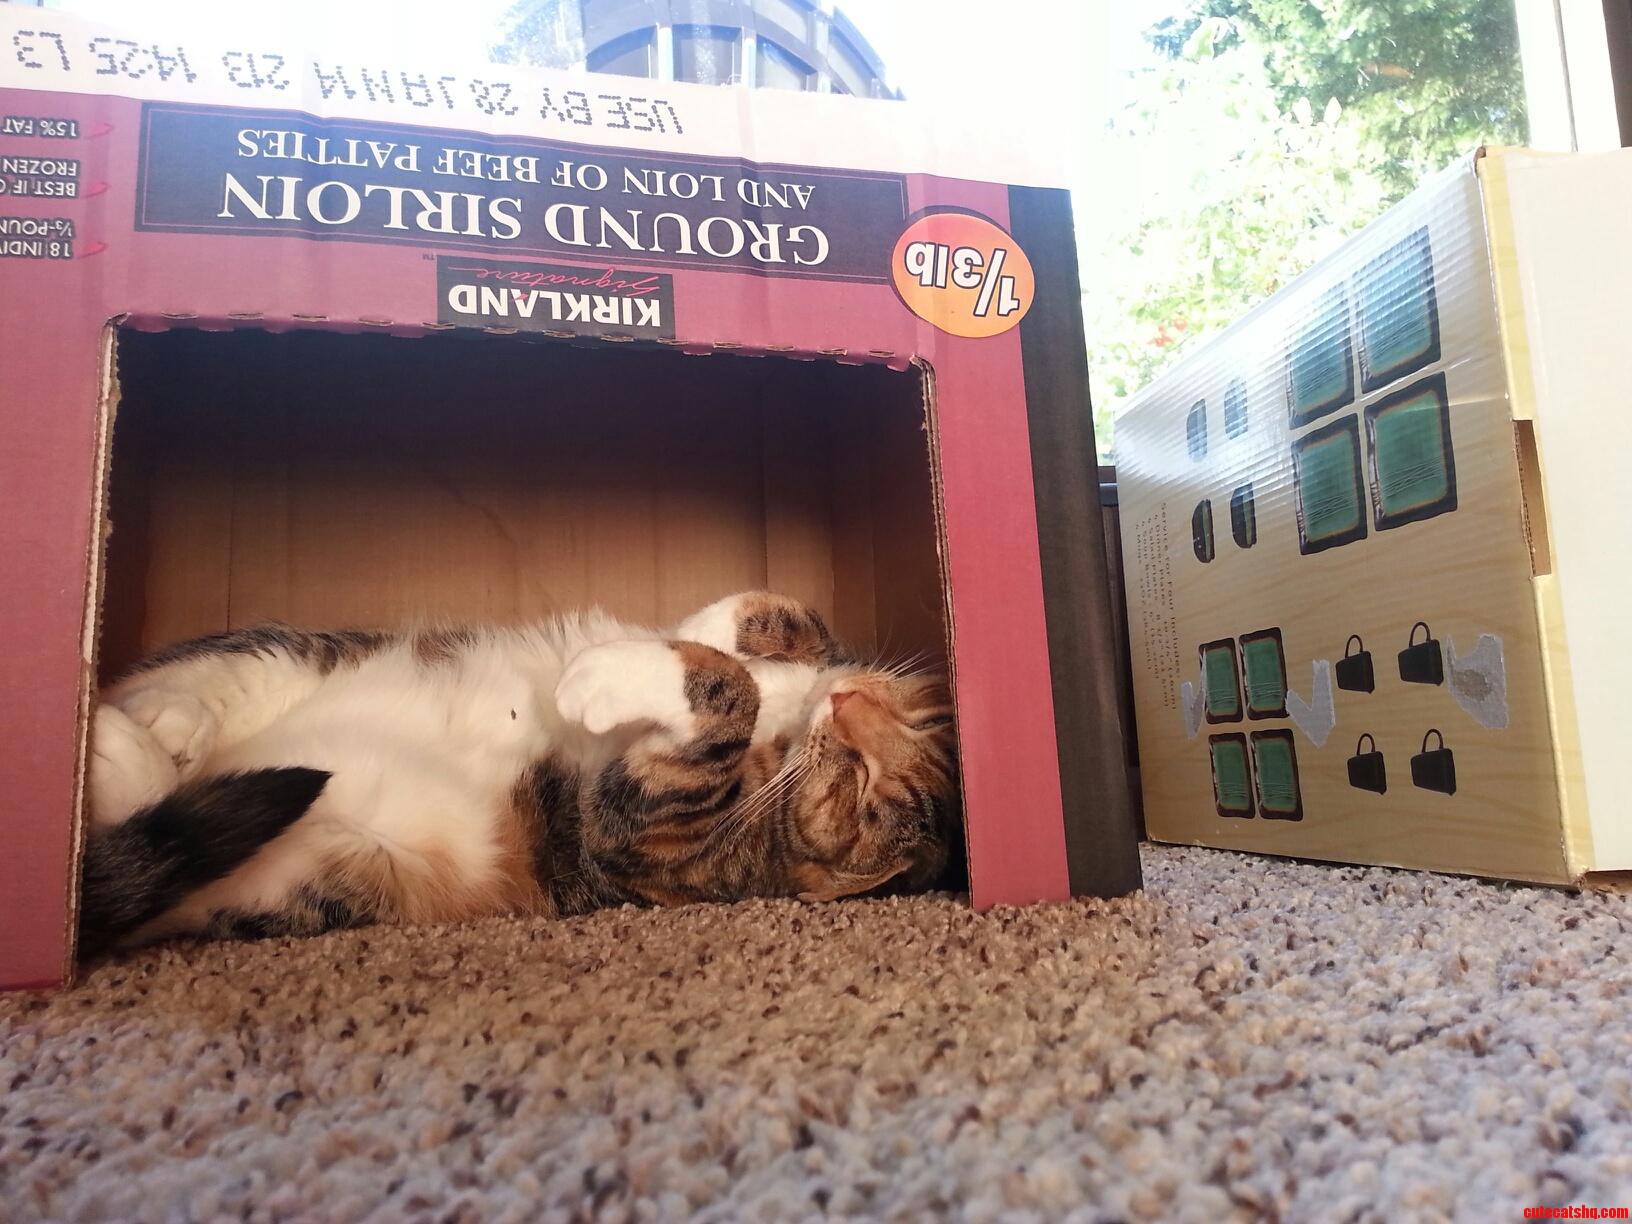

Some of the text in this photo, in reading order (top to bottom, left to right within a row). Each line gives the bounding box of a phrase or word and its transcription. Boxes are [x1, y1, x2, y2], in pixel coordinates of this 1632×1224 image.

[12, 30, 72, 72] L3
[468, 79, 519, 117] 28
[540, 87, 593, 126] BY
[597, 93, 684, 135] USE
[3, 118, 78, 138] 15% FAT
[13, 179, 28, 194] IF
[34, 180, 76, 197] BEST
[236, 129, 817, 211] AND LOIN OF BEEF PATTIES
[216, 173, 831, 267] GROUND SIRLOIN
[50, 241, 72, 258] 18
[447, 266, 662, 297] Signature
[447, 283, 662, 328] KIRKLAND
